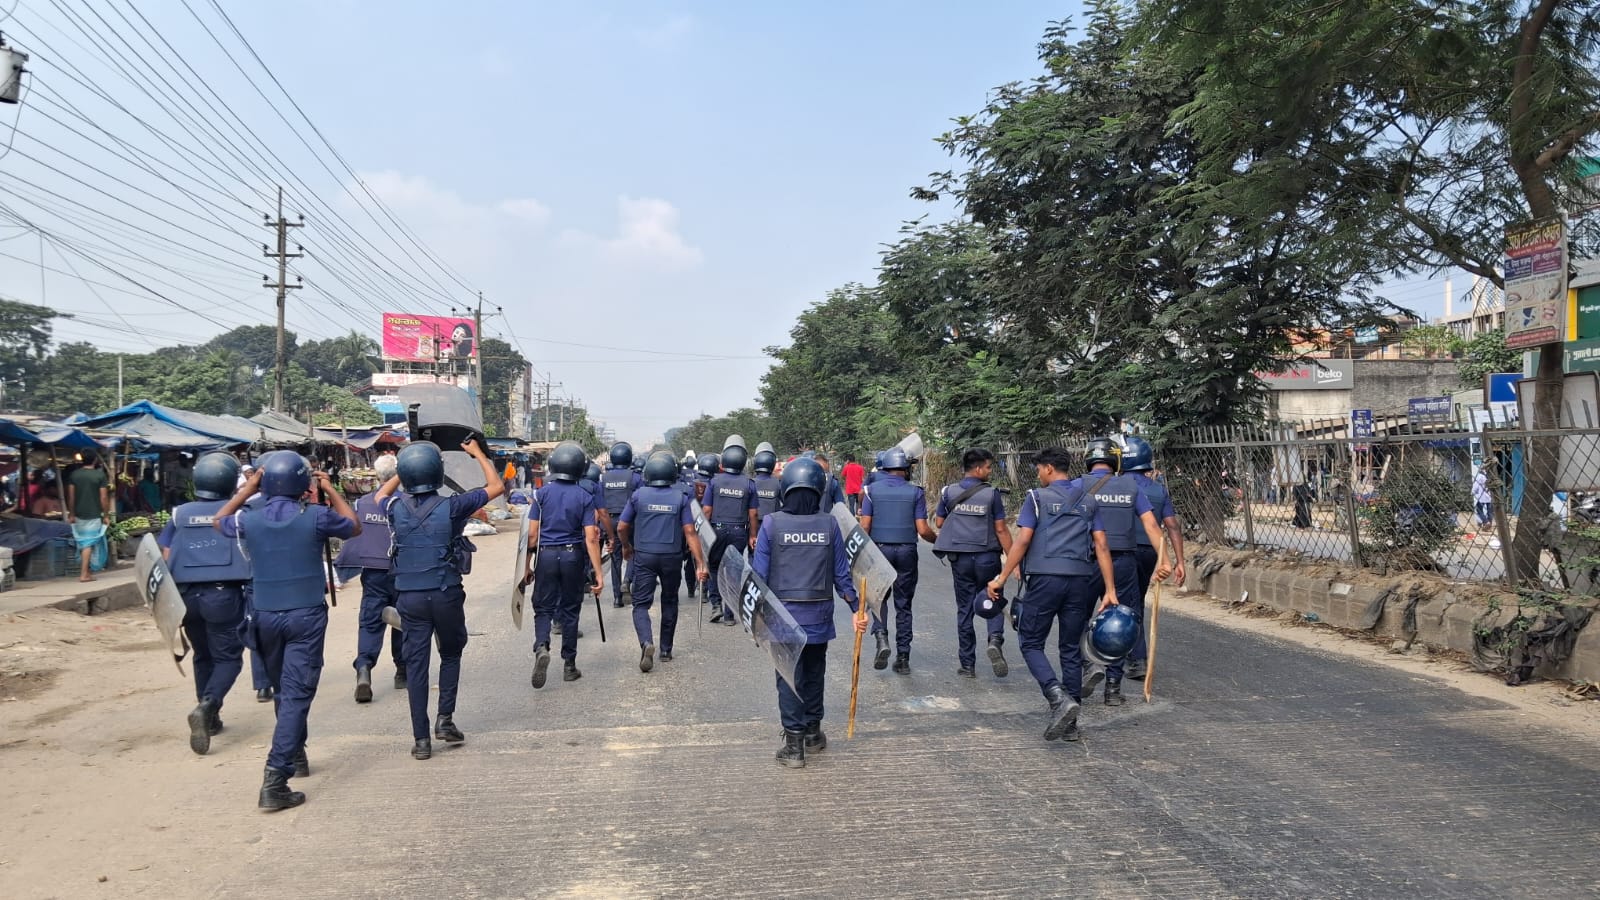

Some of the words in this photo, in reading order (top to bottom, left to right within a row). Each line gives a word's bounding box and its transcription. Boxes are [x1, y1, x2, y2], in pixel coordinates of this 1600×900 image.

[719, 488, 744, 496] POLICE
[1094, 494, 1132, 503] POLICE
[955, 503, 985, 513] POLICE
[784, 533, 825, 543] POLICE
